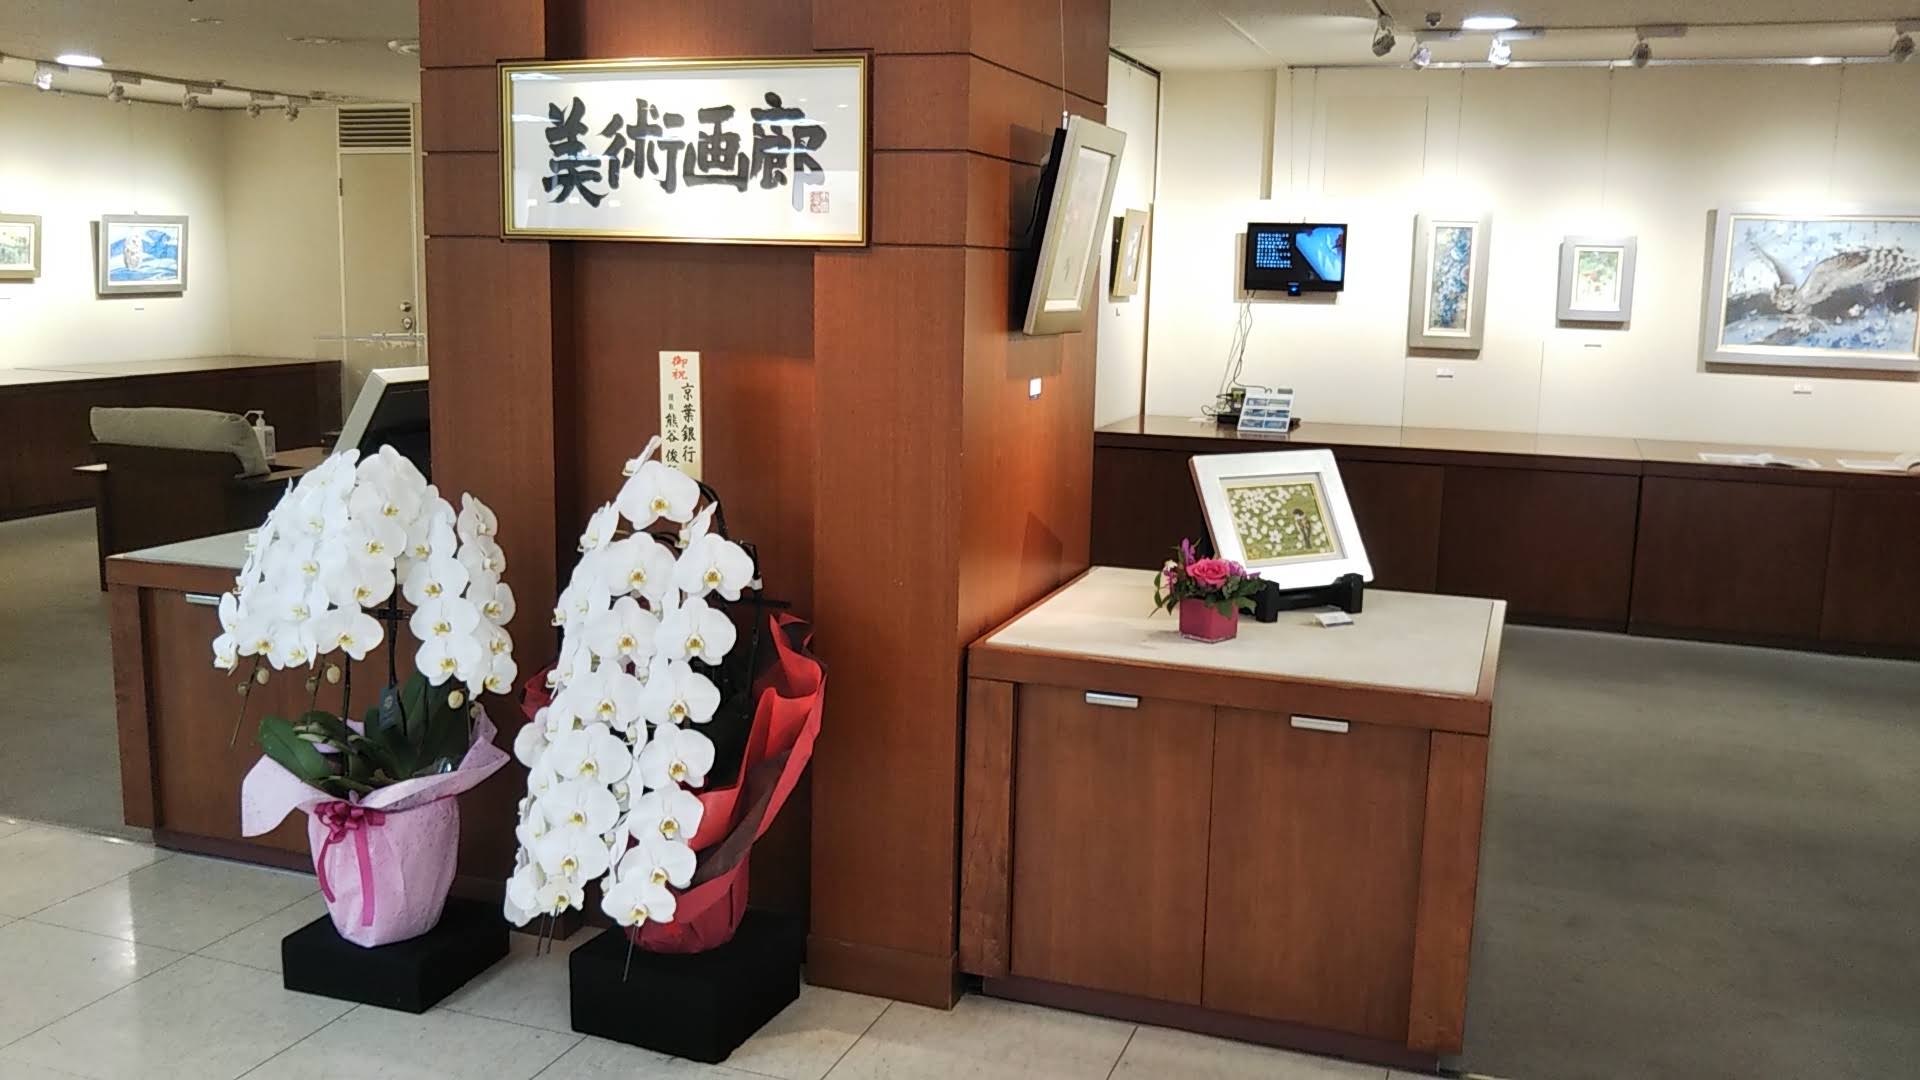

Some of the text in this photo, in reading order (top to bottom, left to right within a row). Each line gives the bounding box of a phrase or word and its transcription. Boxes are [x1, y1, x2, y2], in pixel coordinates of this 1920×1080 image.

[542, 91, 827, 212] 美術画廊
[672, 355, 688, 380] 御祝
[681, 382, 696, 463] 京葉銀行
